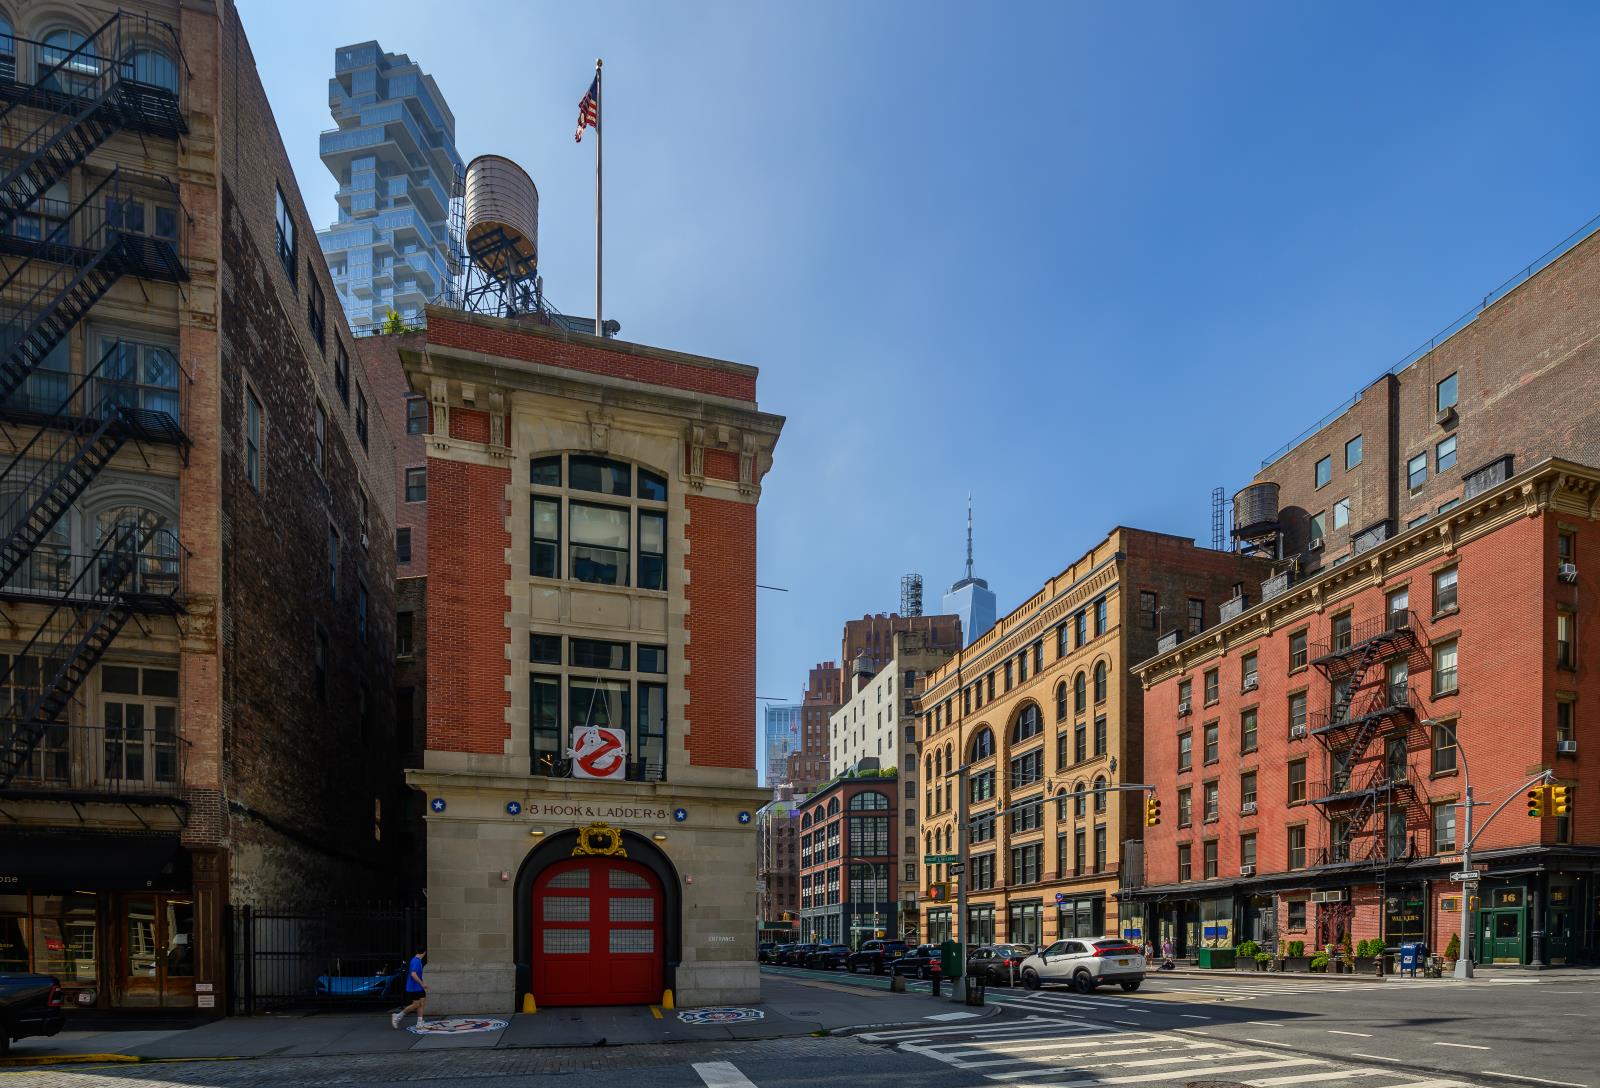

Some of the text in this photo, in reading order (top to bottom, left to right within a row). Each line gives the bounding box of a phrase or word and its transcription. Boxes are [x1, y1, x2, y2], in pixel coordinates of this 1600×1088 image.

[529, 804, 666, 819] 8 HOOK & LADDER 8
[1502, 893, 1517, 903] 16
